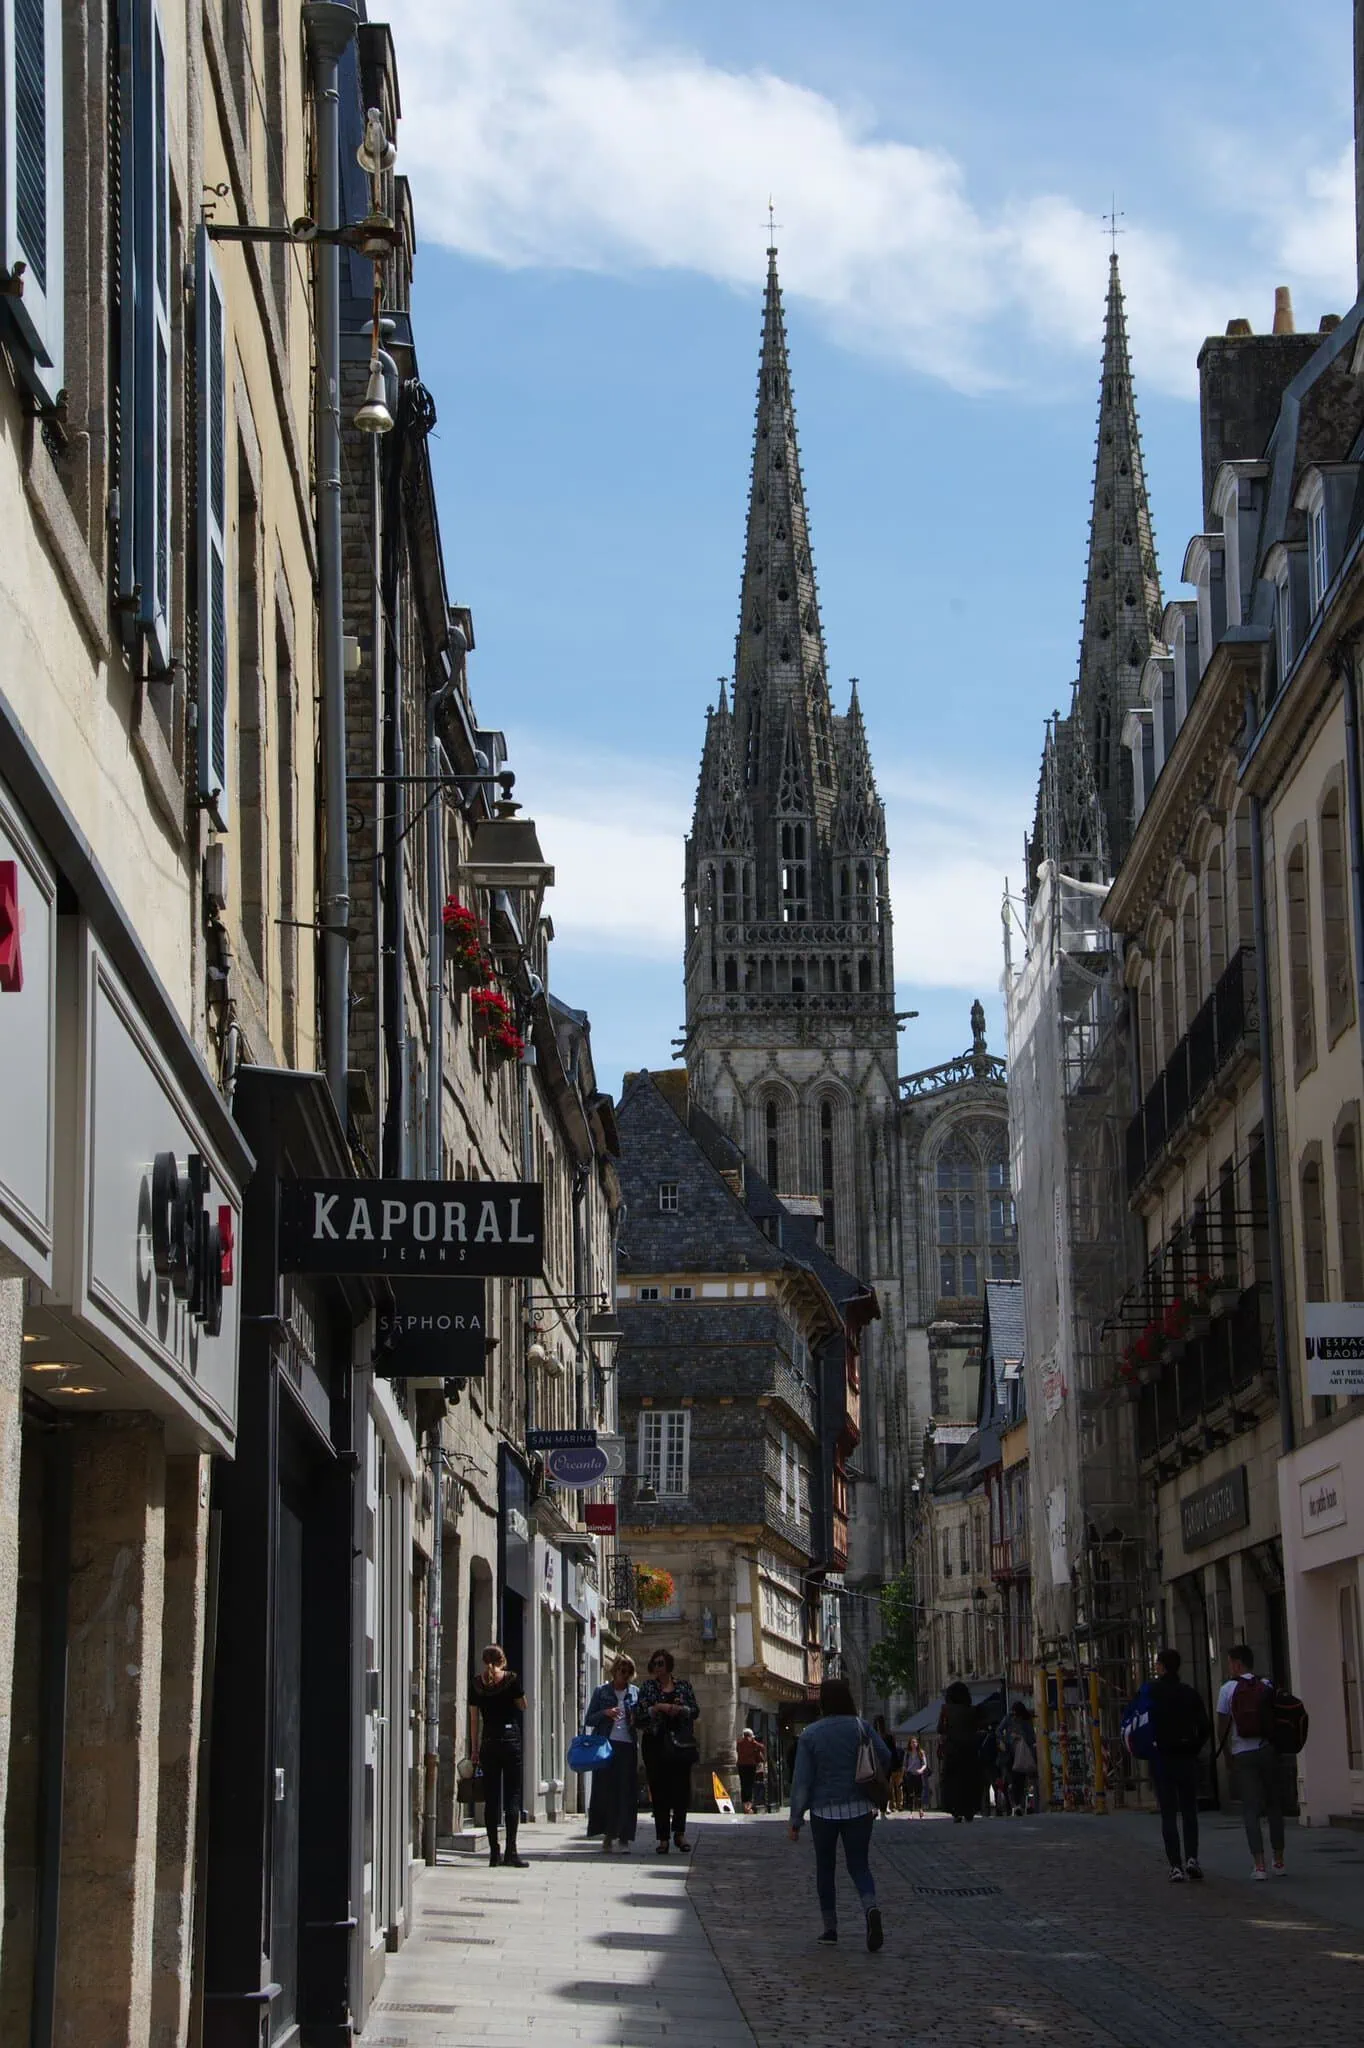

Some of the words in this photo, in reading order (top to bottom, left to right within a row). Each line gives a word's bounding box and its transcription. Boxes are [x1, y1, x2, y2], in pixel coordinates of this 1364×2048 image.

[313, 1192, 535, 1243] KAPORAL
[383, 1248, 466, 1261] JEANS
[532, 1436, 551, 1444] SAN
[555, 1435, 593, 1443] MARINA
